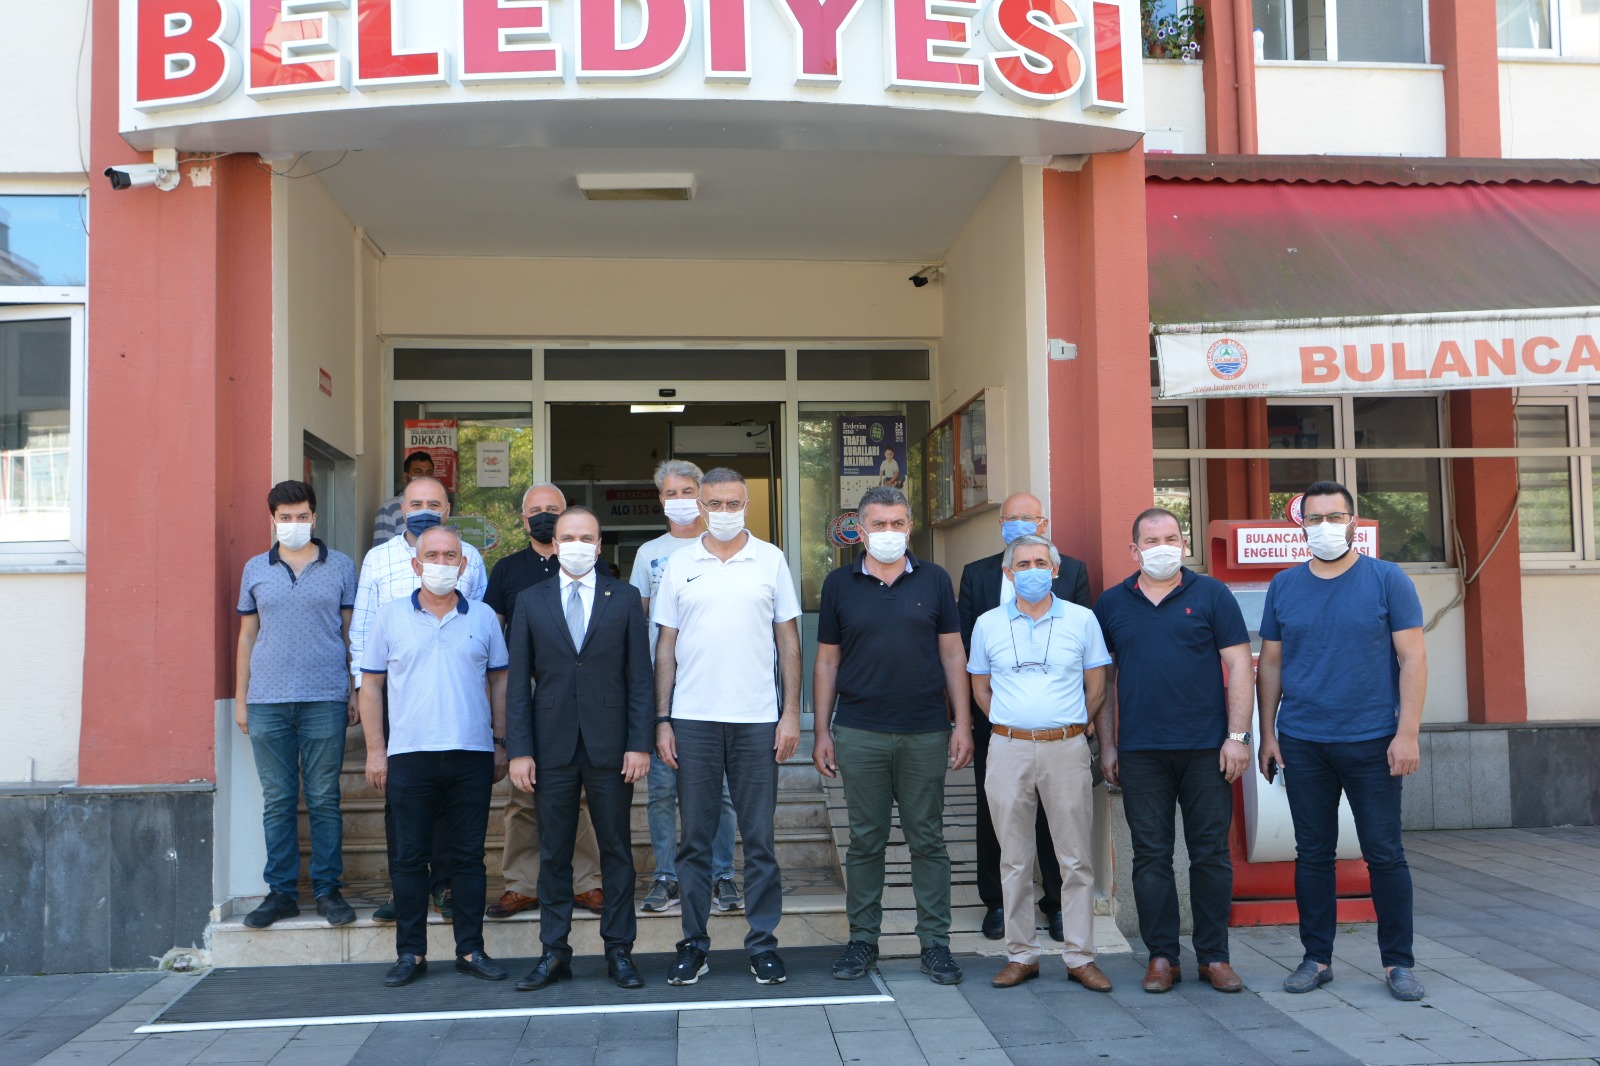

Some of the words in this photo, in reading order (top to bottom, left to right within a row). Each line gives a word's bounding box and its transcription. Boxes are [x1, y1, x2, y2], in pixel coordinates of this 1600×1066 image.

[1299, 335, 1600, 384] BULANCA
[1192, 382, 1269, 393] www.bulancak.bel.tr
[843, 446, 880, 456] KURALLARI
[611, 505, 630, 516] ALO
[632, 505, 649, 515] 153
[1246, 533, 1306, 544] BULANCAK
